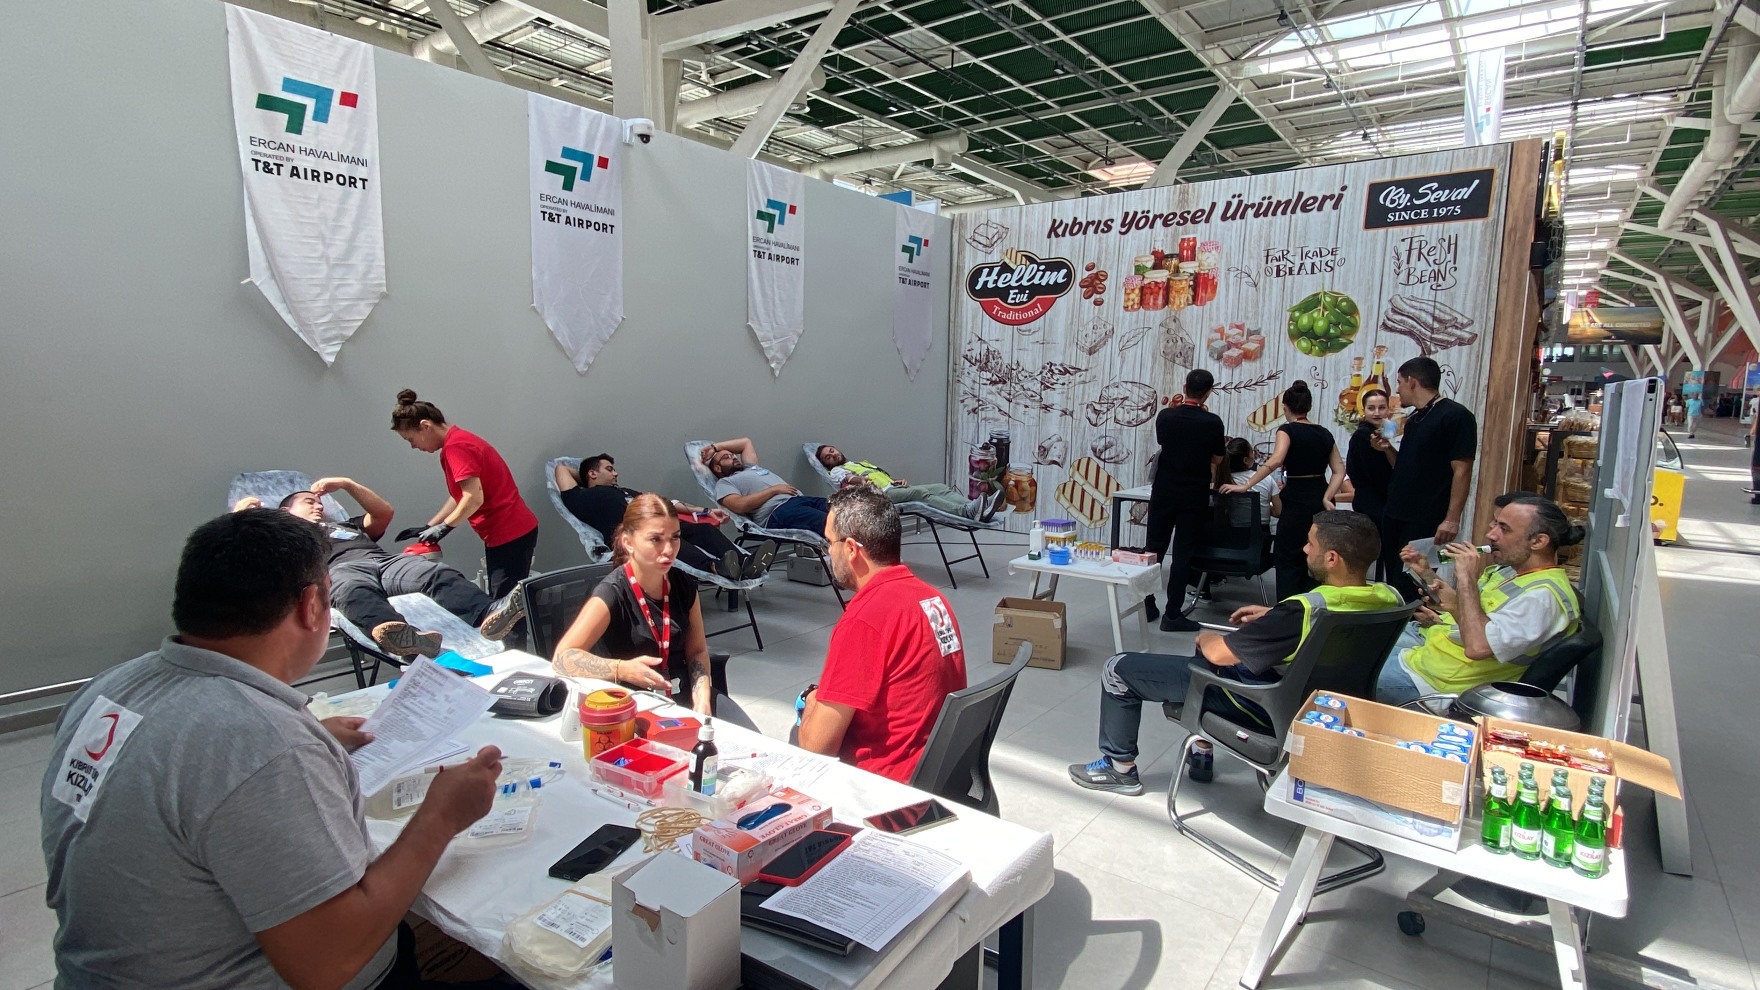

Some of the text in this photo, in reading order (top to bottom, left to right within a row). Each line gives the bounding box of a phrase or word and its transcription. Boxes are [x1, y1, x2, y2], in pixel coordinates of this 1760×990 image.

[250, 136, 368, 168] ERCAN HAVALİMANI
[250, 149, 285, 162] OPERATED
[251, 158, 369, 190] T&T AIRPORT
[540, 193, 615, 216] ERCAN HAVALİMANI
[1046, 184, 1349, 240] Kıbrıs Yöresel Ürünleri
[1387, 205, 1462, 222] SINCE 1975
[540, 210, 615, 234] T&T AIRPORT
[753, 236, 771, 246] ERCAN
[753, 249, 800, 266] T&T AIRPORT
[975, 264, 1068, 290] Hellim
[1274, 259, 1335, 278] BEANS
[1399, 260, 1458, 291] BEANS
[908, 279, 930, 289] AIRPORT
[1006, 289, 1030, 304] Evi
[991, 303, 1043, 320] Traditional
[759, 824, 785, 840] GLOVE
[768, 832, 788, 846] GREAT
[788, 822, 808, 837] GLOVE
[699, 835, 715, 849] GREAT
[715, 844, 731, 857] GLOVE
